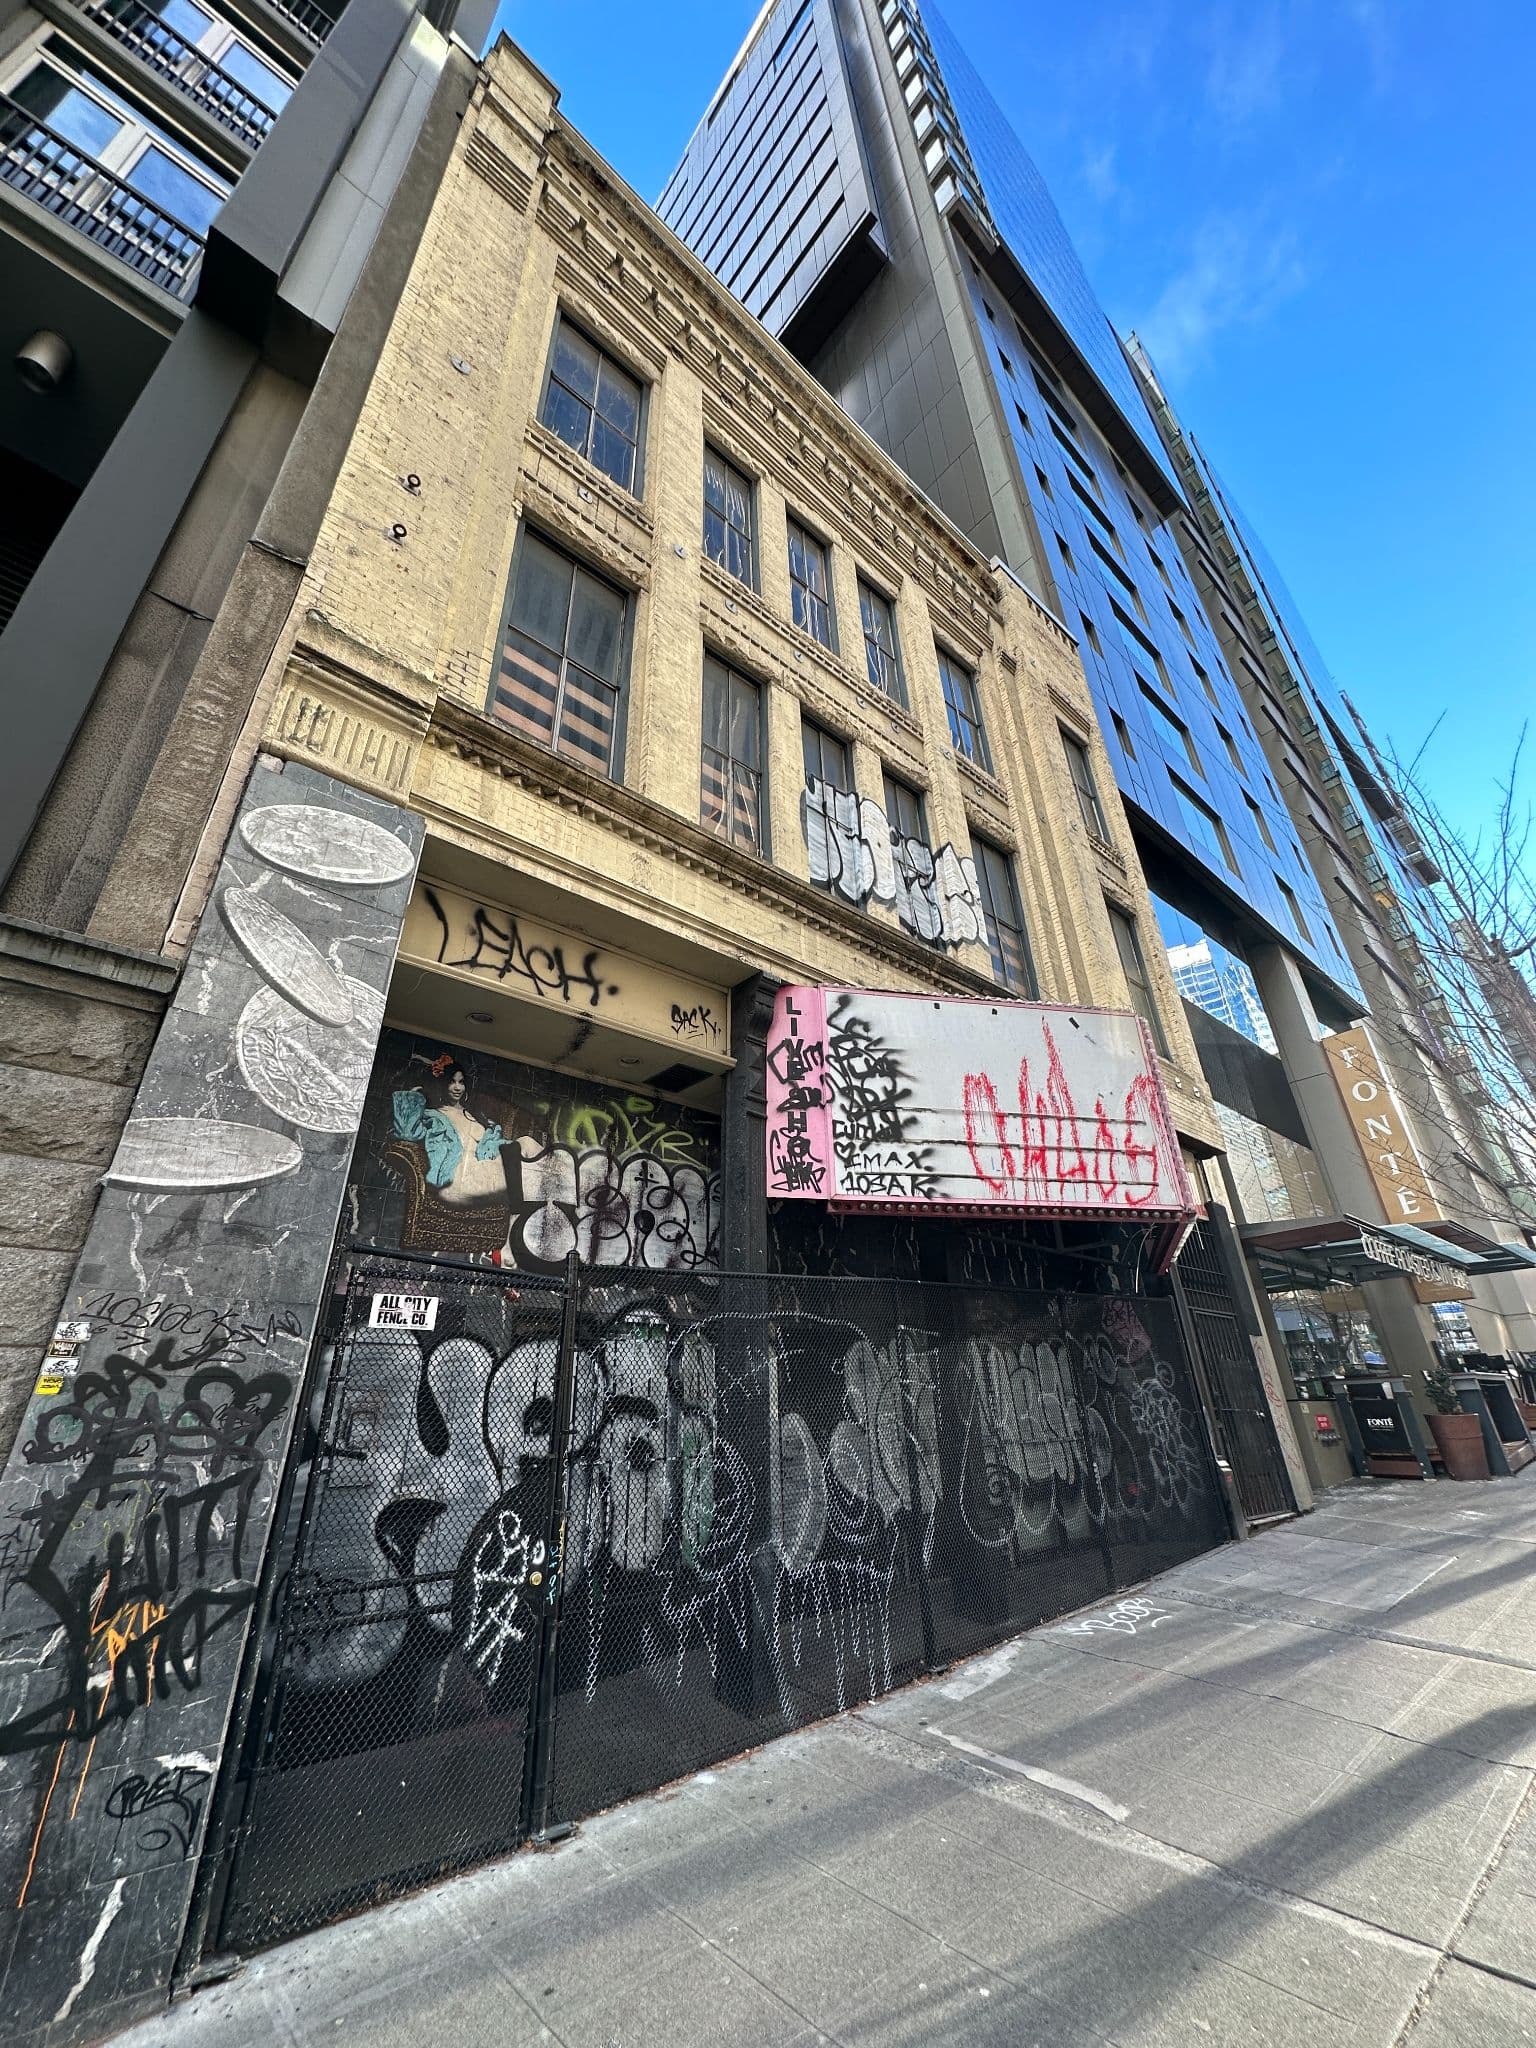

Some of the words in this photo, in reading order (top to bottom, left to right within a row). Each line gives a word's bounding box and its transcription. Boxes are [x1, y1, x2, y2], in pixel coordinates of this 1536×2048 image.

[1339, 1045, 1421, 1216] FONTÉ
[380, 1295, 401, 1309] ALL
[411, 1313, 428, 1326] CO.
[1367, 1417, 1394, 1426] FONTÉ
